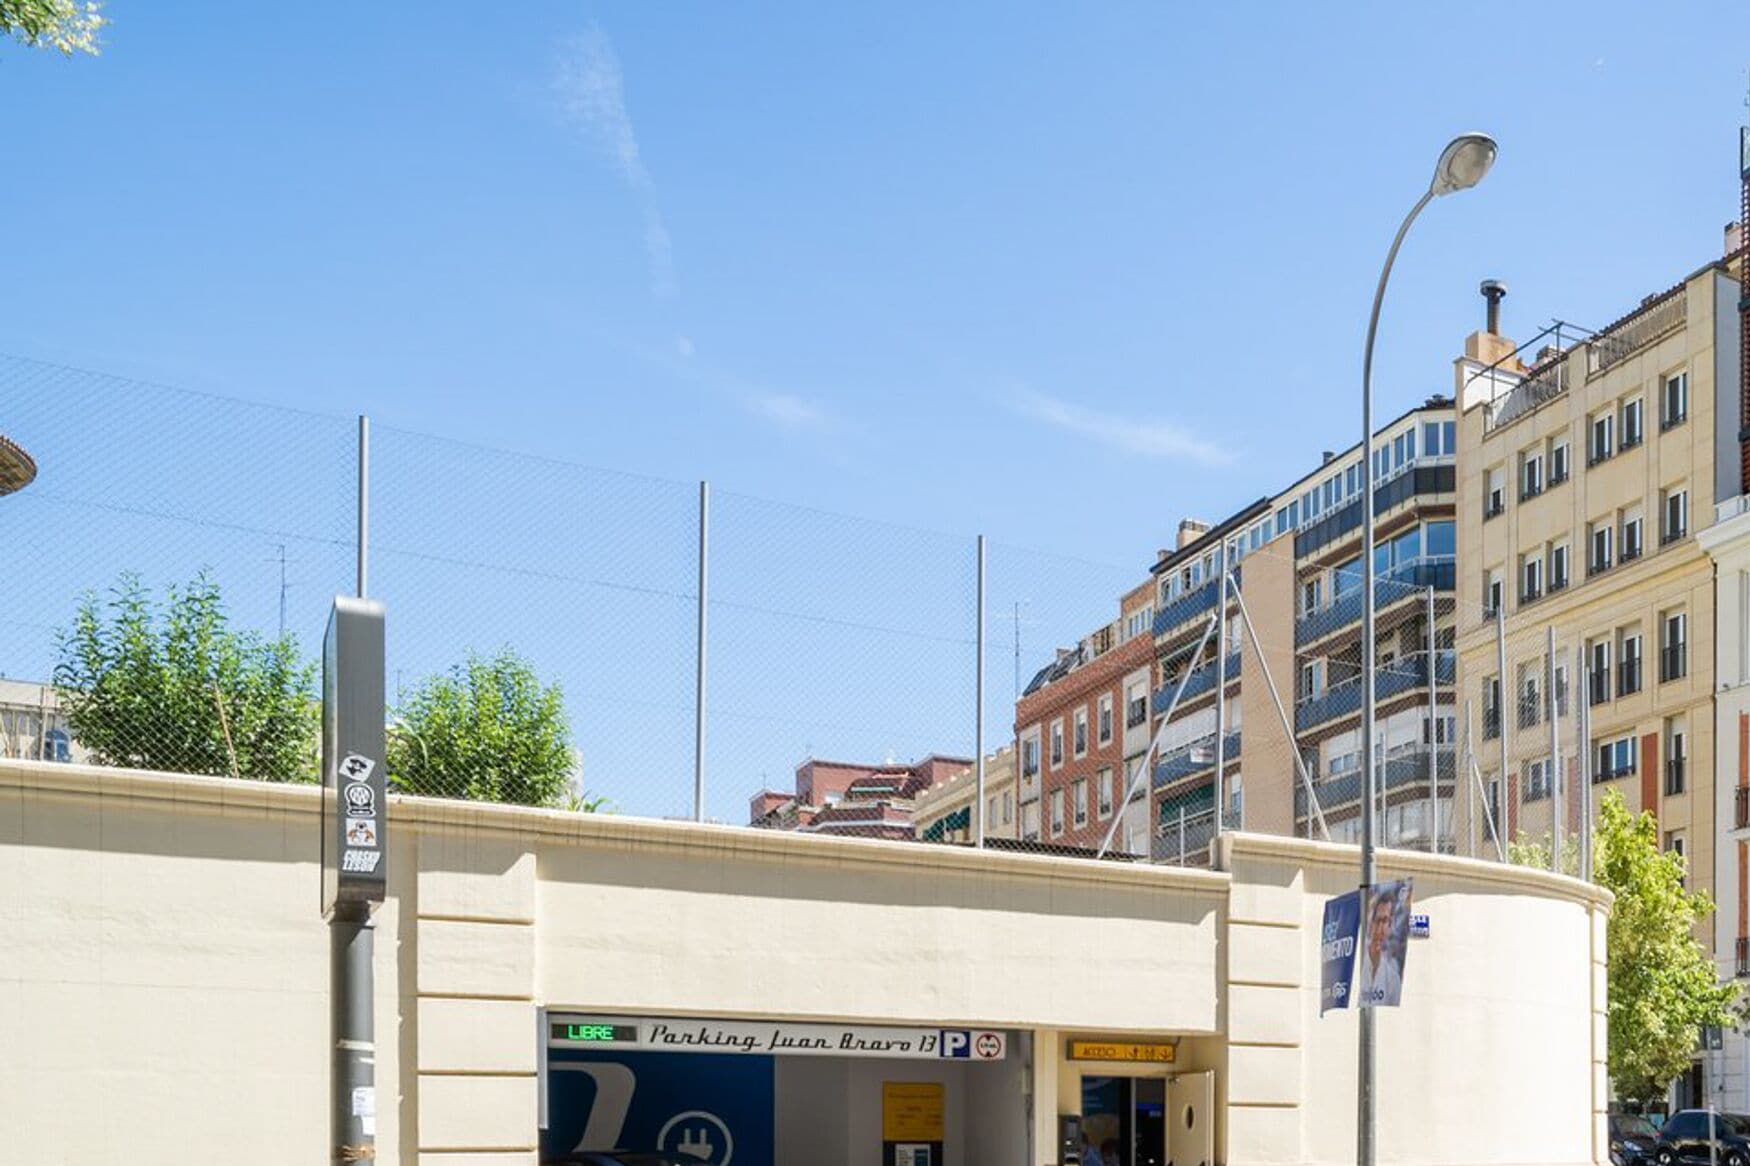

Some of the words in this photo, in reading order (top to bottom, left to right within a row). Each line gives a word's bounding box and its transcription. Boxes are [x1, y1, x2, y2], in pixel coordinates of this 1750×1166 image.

[567, 1024, 614, 1041] LIBRE
[650, 1025, 761, 1051] Parking
[768, 1029, 833, 1051] Juan
[839, 1031, 912, 1052] Bravo
[918, 1034, 938, 1053] 13
[943, 1031, 968, 1057] P
